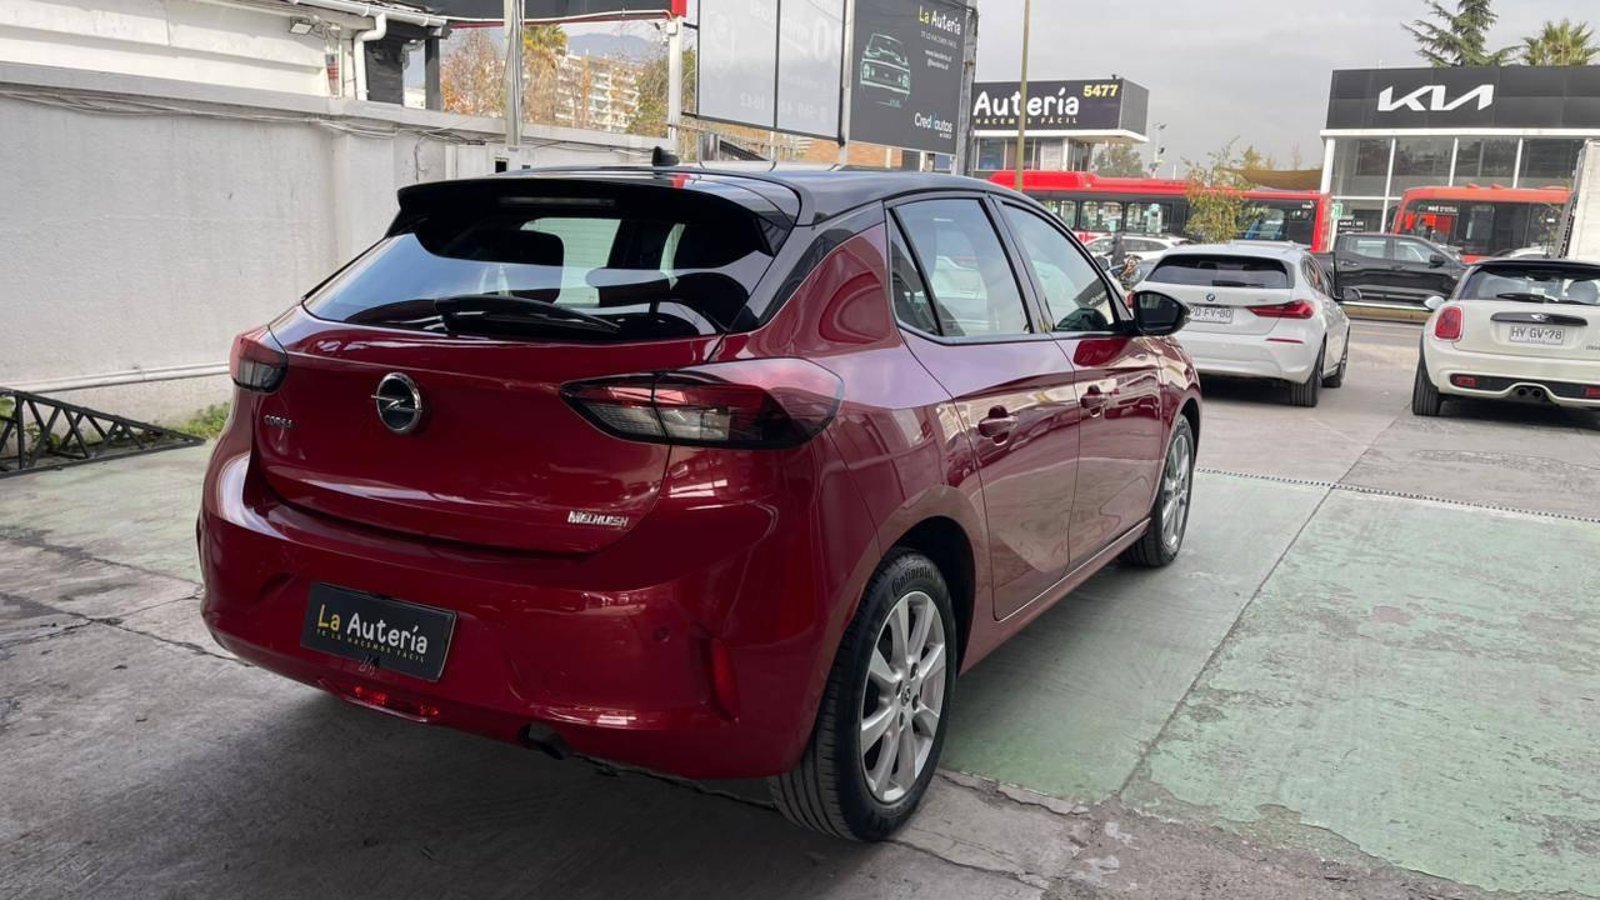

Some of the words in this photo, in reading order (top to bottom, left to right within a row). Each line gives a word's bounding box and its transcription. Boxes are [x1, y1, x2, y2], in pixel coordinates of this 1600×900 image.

[919, 5, 930, 24] La
[973, 87, 1080, 116] Autería
[1083, 84, 1119, 97] 5477
[1377, 84, 1494, 111] KIA
[317, 603, 341, 632] La
[346, 612, 428, 654] Autería
